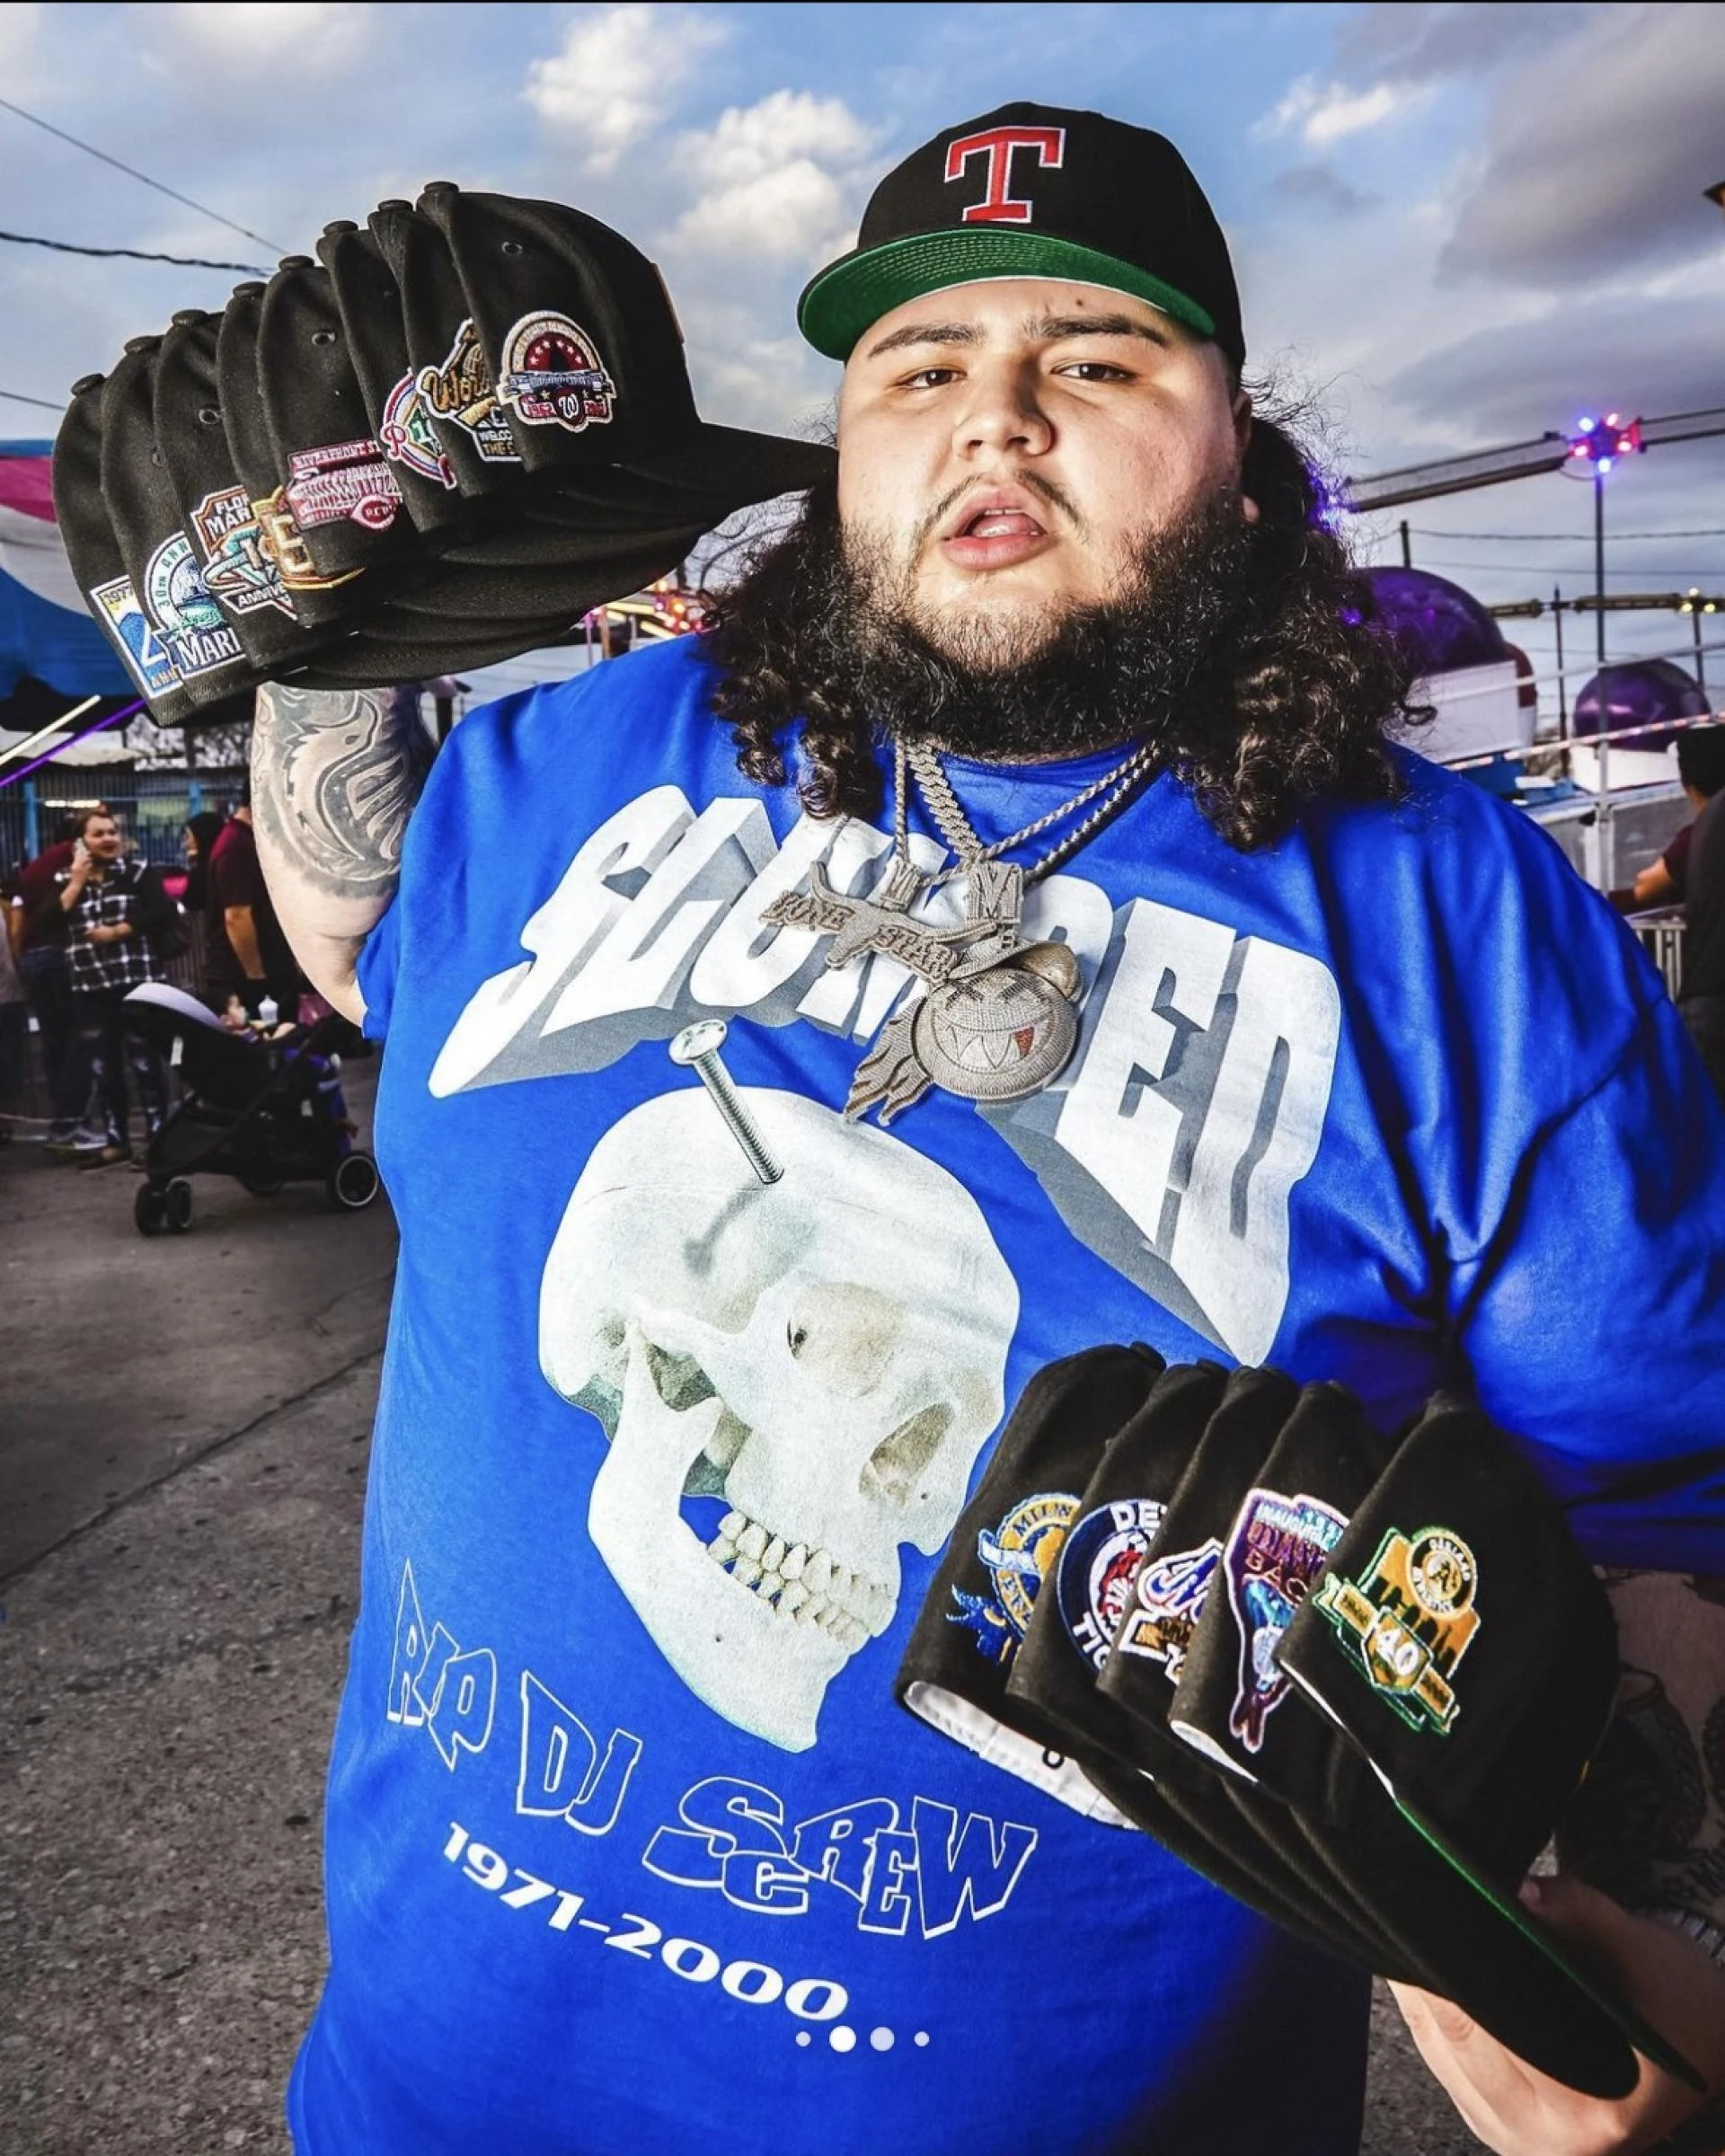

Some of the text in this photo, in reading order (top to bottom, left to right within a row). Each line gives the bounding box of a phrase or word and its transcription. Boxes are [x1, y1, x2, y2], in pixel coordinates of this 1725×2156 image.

[944, 125, 1066, 223] T
[1110, 1502, 1167, 1532] DE
[516, 1670, 643, 1837] DJ
[641, 1776, 1039, 1940] SCREW
[441, 1822, 849, 2022] 1971-2000
